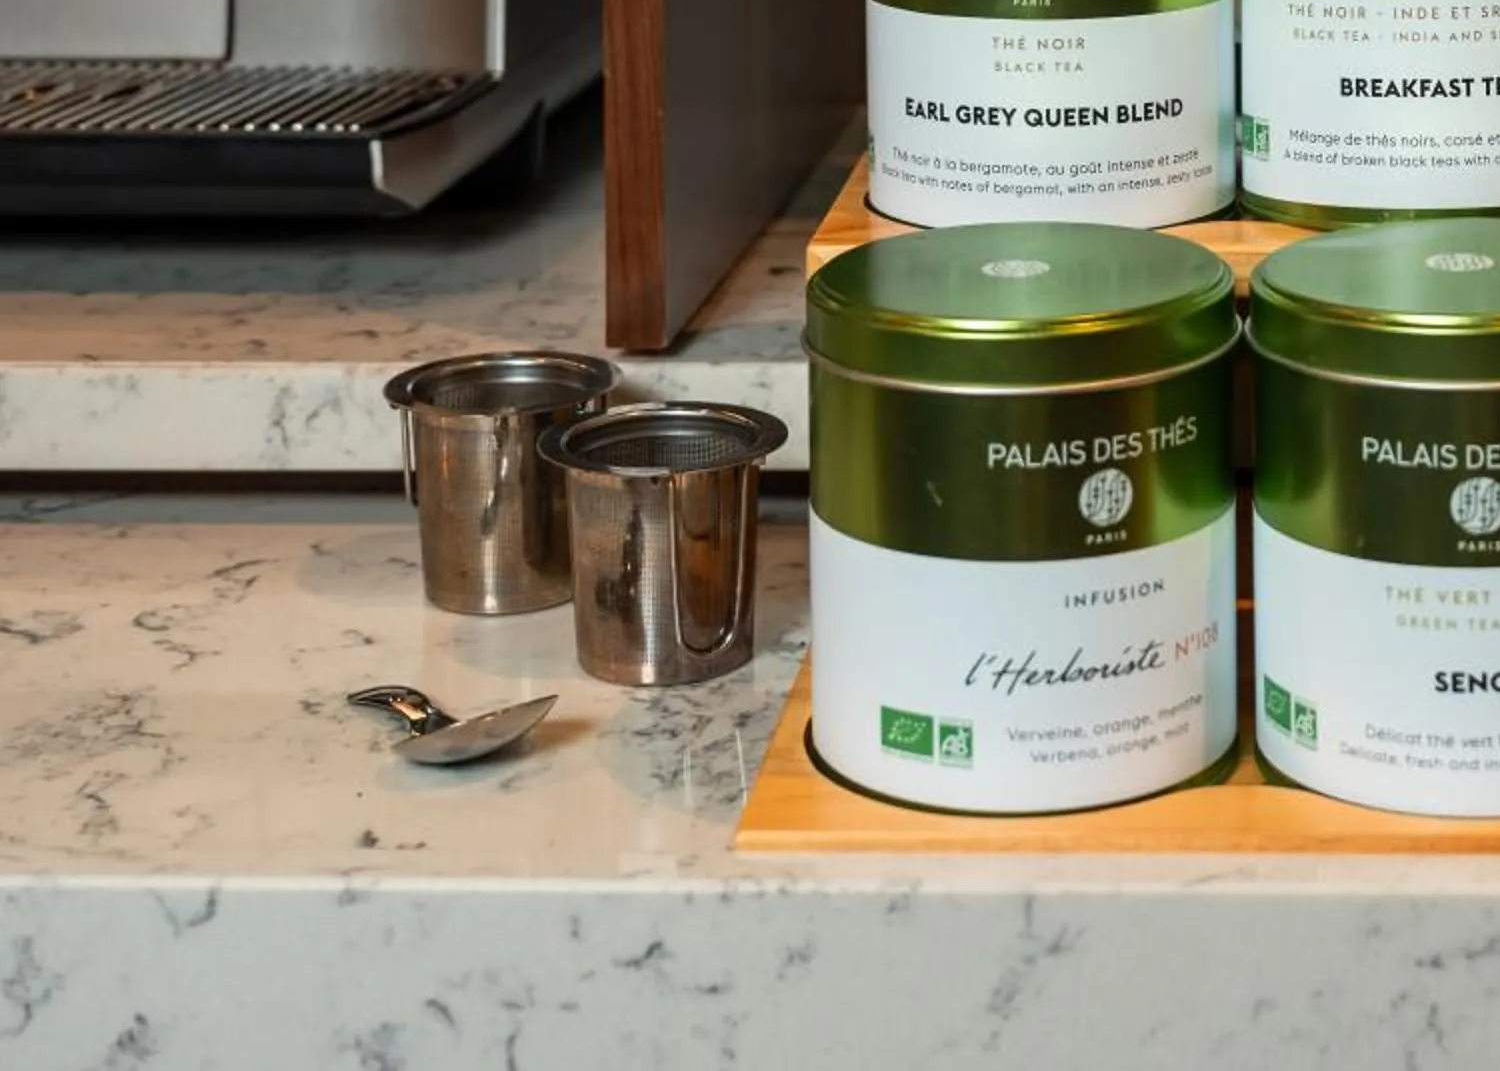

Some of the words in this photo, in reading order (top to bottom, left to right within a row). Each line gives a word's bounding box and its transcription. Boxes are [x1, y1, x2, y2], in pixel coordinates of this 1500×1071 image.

[1288, 3, 1314, 17] THÉ
[1323, 6, 1366, 20] NOIR
[1393, 6, 1441, 20] INDE
[1451, 6, 1471, 20] ET
[992, 36, 1026, 50] THÉ
[1037, 37, 1086, 51] NOIR
[1293, 28, 1335, 41] BLACK
[1343, 30, 1370, 42] TEA
[1393, 31, 1440, 43] INDIA
[1450, 30, 1483, 42] AND
[994, 61, 1045, 73] BLACK
[1055, 61, 1084, 73] TEA
[1339, 77, 1475, 99] BREAKFAST
[905, 97, 950, 122] EARL
[956, 105, 1017, 126] GREY
[1024, 106, 1109, 127] QUEEN
[1116, 98, 1183, 124] BLEND
[1289, 129, 1341, 148] Mélange
[1343, 133, 1362, 146] de
[1365, 134, 1396, 147] thés
[1443, 134, 1483, 147] corsé
[1487, 134, 1500, 146] et
[945, 158, 957, 170] la
[960, 159, 1041, 177] bergamote,
[1045, 164, 1064, 175] au
[1069, 162, 1103, 177] goût
[1107, 157, 1153, 174] intense
[1158, 154, 1170, 167] et
[1284, 149, 1292, 160] A
[1293, 150, 1323, 164] blend
[1325, 152, 1338, 165] of
[1341, 154, 1386, 167] broken
[1389, 155, 1427, 168] black
[1431, 156, 1460, 168] teas
[1464, 155, 1491, 166] with
[942, 179, 973, 192] notes
[976, 181, 990, 194] of
[994, 181, 1063, 197] bergamot,
[1068, 182, 1095, 195] with
[1098, 182, 1115, 193] an
[987, 440, 1086, 469] PALAIS
[1093, 433, 1143, 463] DES
[1147, 416, 1198, 453] THÉS
[1362, 436, 1458, 469] PALAIS
[1085, 530, 1128, 545] PARIS
[1065, 578, 1166, 610] INFUSION
[1437, 589, 1491, 605] VERT
[1396, 614, 1458, 630] GREEN
[1007, 726, 1088, 743] Verveine,
[1092, 714, 1153, 735] orange,
[1158, 693, 1203, 720] menthe
[1462, 736, 1494, 748] vert
[1448, 757, 1480, 771] and
